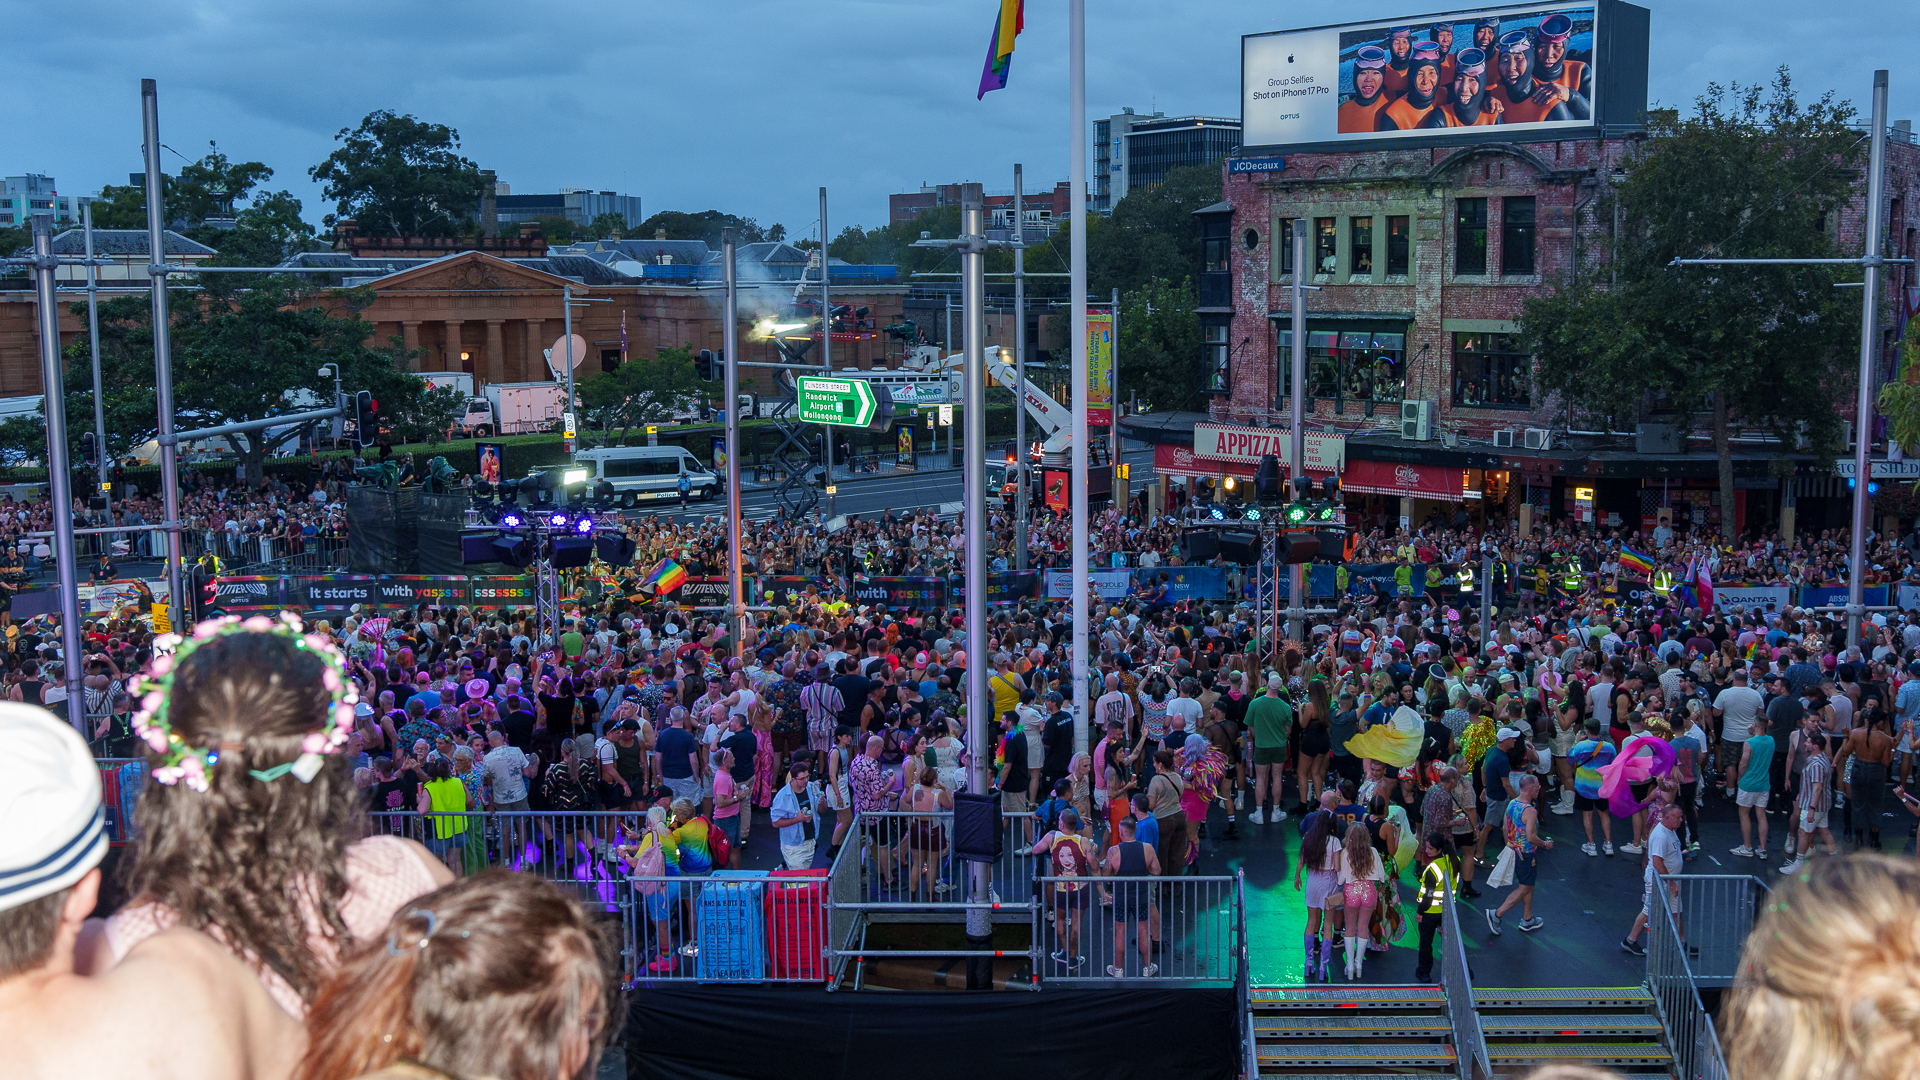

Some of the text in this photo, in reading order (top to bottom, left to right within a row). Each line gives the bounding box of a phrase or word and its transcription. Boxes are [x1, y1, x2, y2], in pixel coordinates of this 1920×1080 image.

[1268, 75, 1314, 87] Group Selfies
[1253, 91, 1270, 100] Shot
[1281, 88, 1307, 98] iPhone
[1307, 86, 1315, 95] 17
[1316, 85, 1329, 94] Pro
[1234, 162, 1279, 171] JCDecaux
[805, 382, 829, 390] FLINDERS
[805, 392, 838, 402] Randwick
[809, 402, 834, 411] Airport
[803, 411, 841, 422] Wollongong
[1216, 432, 1282, 459] APPIZZA
[1307, 439, 1322, 447] SLICE
[1308, 455, 1322, 463] BEER
[1839, 463, 1919, 474] TOL SHED
[245, 583, 268, 596] CLUB
[309, 587, 368, 598] It starts
[382, 585, 413, 597] with
[682, 583, 729, 597] GLITTER CLU
[855, 587, 888, 599] with
[775, 897, 797, 905] ENERAL
